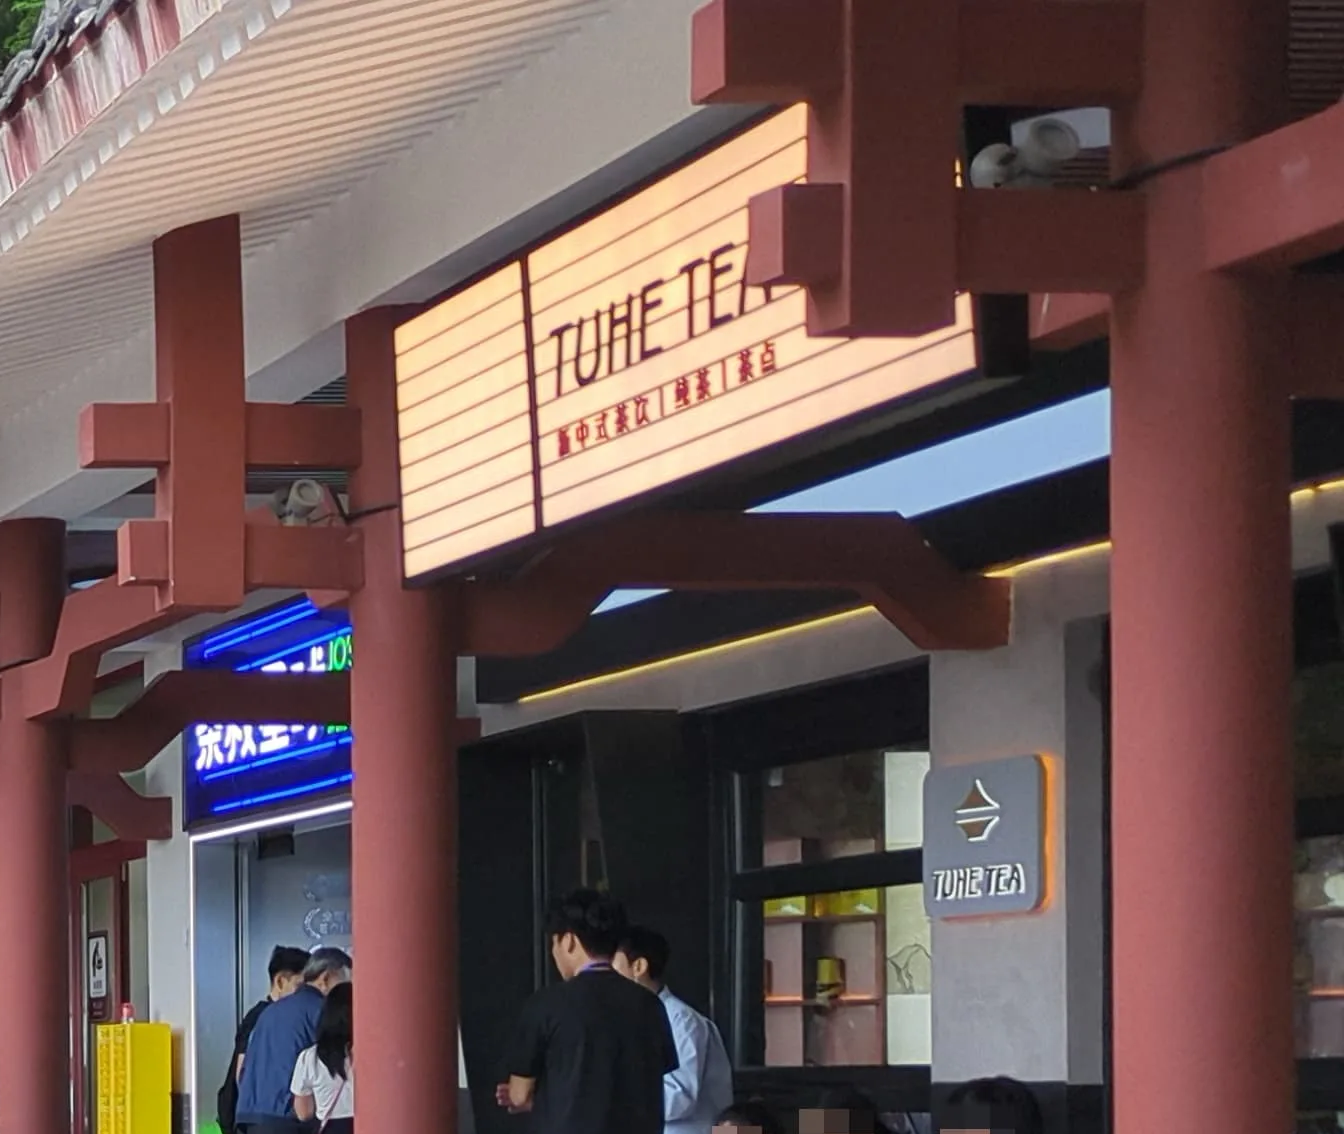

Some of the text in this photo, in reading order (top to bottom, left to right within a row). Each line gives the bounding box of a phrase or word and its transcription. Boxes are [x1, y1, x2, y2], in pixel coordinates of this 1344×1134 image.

[550, 277, 663, 398] TUHE
[933, 863, 1025, 900] TUHE TEA
